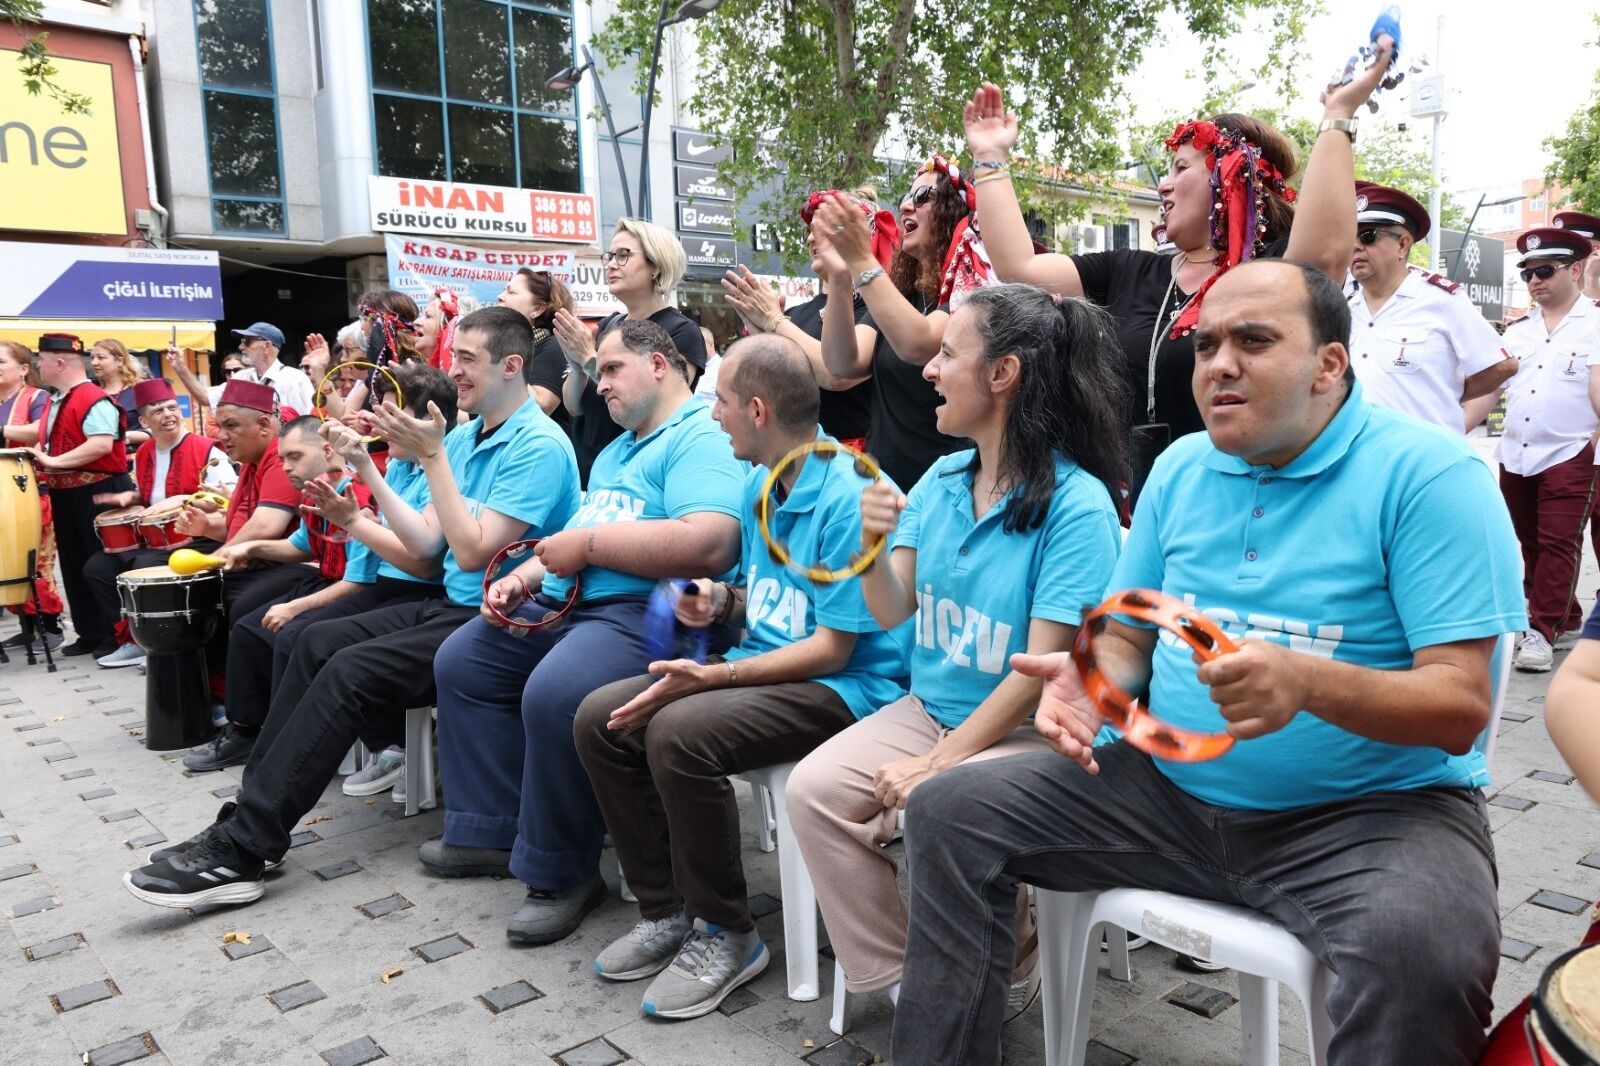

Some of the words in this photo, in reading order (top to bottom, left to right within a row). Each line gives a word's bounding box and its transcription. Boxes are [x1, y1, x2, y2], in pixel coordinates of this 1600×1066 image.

[535, 196, 557, 213] 386
[560, 198, 574, 214] 22
[577, 200, 591, 216] 00
[377, 208, 457, 230] SÜRÜCÜ
[465, 218, 527, 233] KURSU
[536, 217, 558, 234] 386
[561, 219, 575, 235] 20
[578, 221, 592, 236] 55
[403, 241, 477, 262] KASAP
[484, 252, 568, 266] CEVDET
[103, 281, 147, 300] ÇİĞLİ
[149, 281, 213, 302] İLETİŞİM
